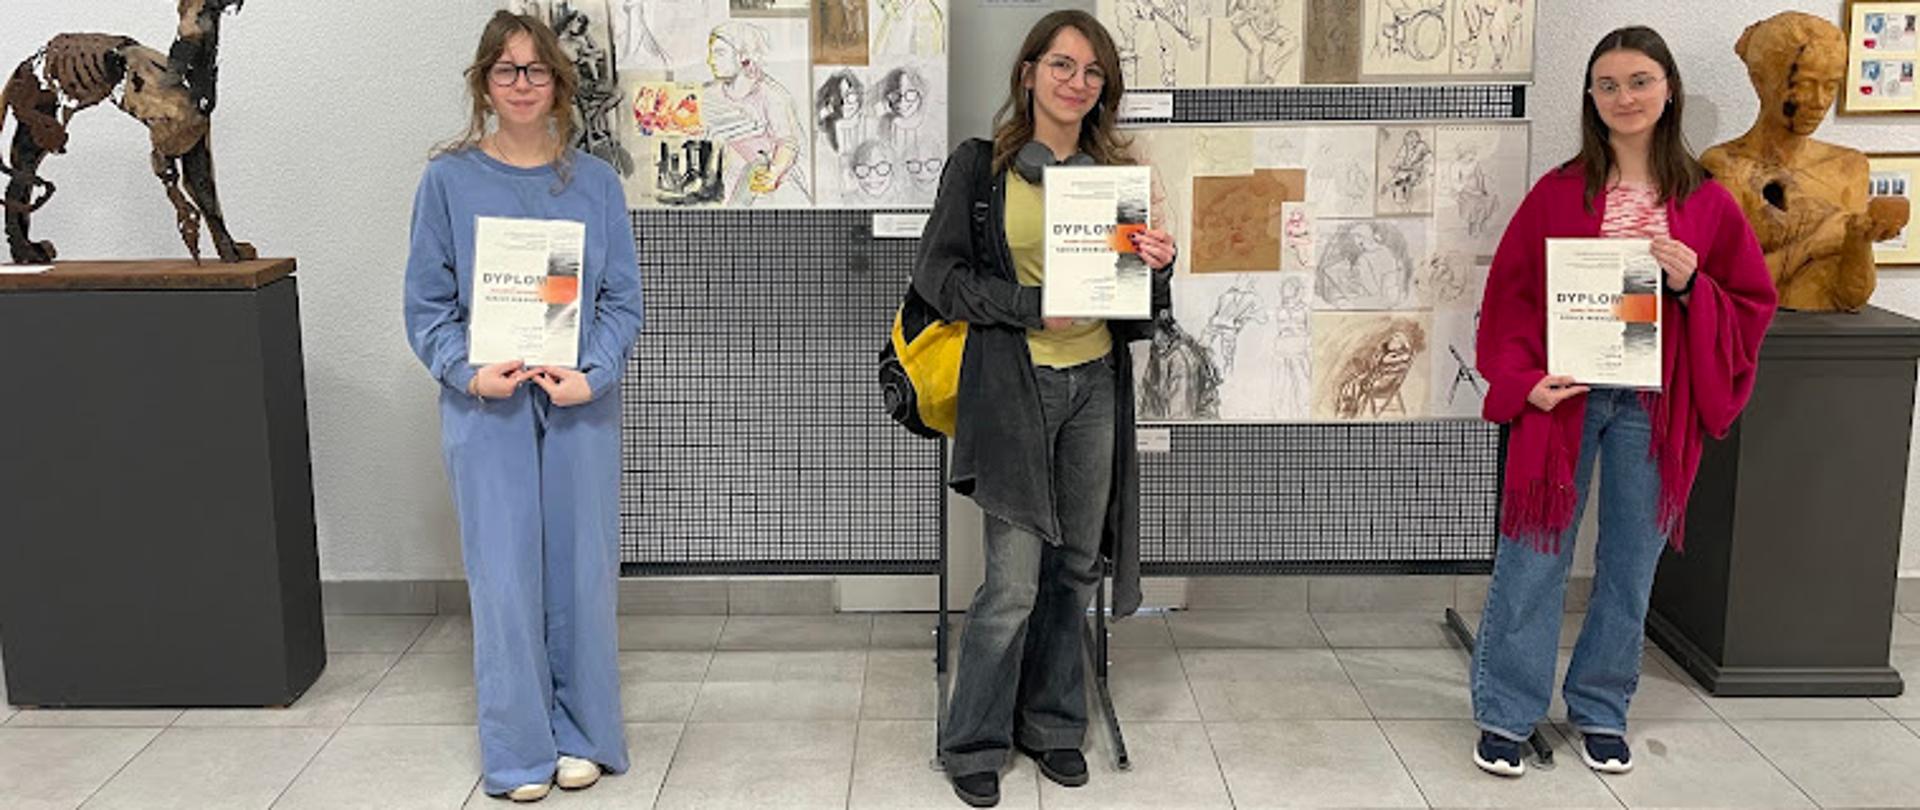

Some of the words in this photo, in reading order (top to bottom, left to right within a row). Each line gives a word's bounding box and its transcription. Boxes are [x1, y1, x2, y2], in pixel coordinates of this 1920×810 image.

[1053, 224, 1117, 236] DYPLOM
[483, 273, 547, 286] DYPLOM
[1557, 293, 1624, 304] DYPLOM
